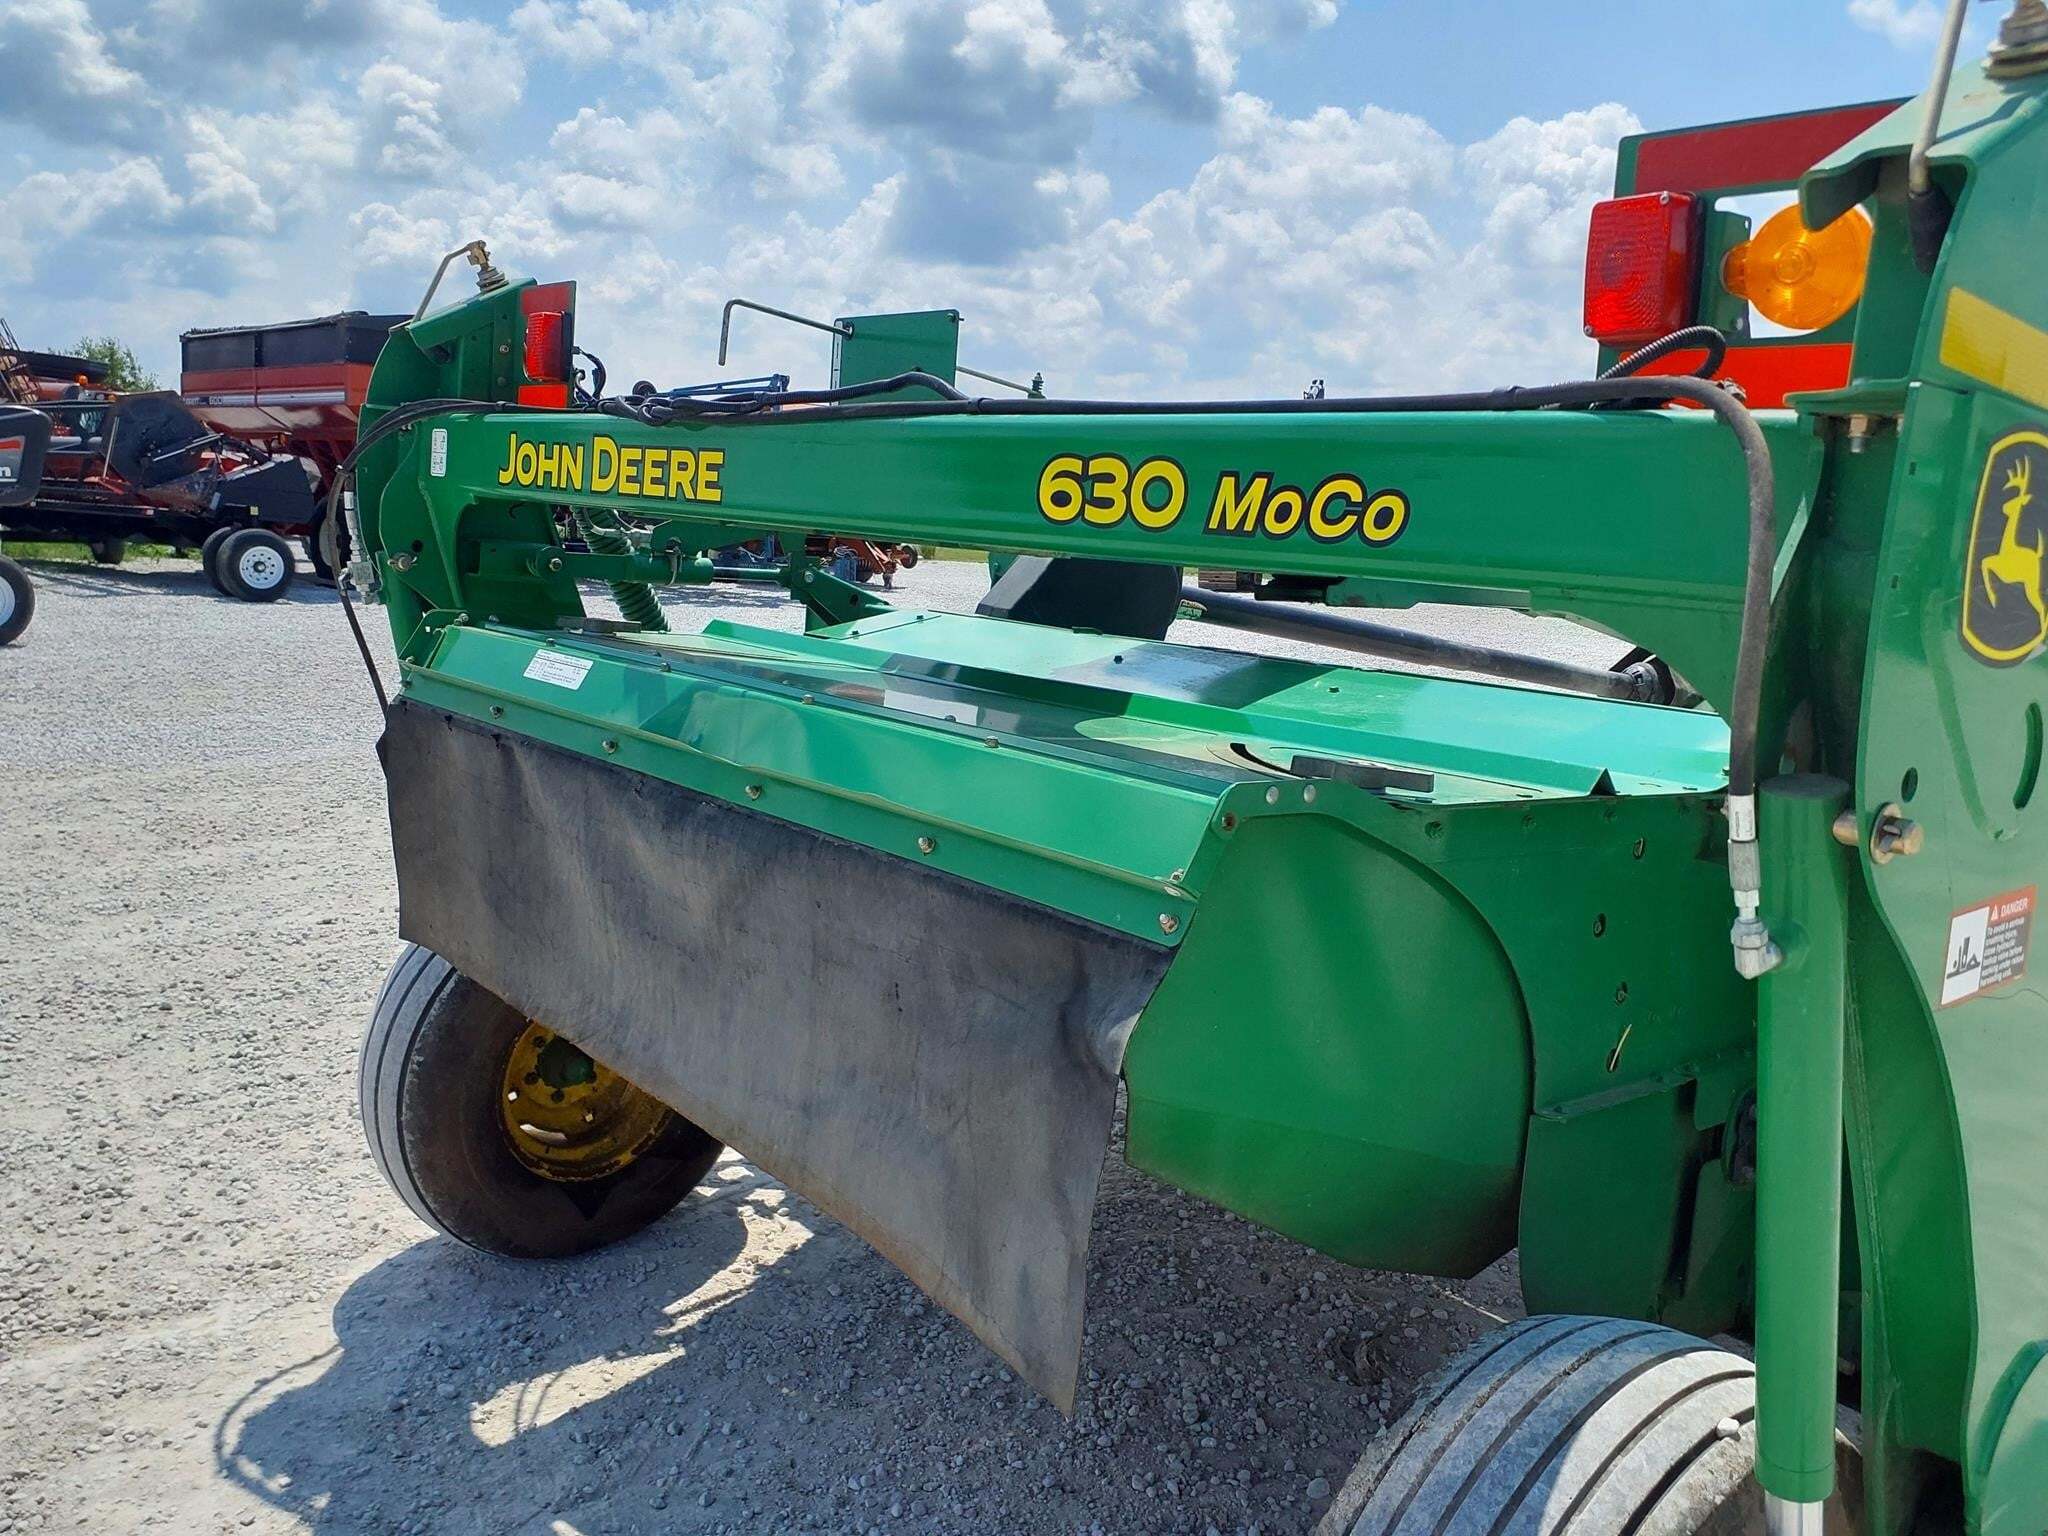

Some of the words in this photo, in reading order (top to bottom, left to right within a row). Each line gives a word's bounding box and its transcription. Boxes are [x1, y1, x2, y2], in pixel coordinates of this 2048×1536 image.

[498, 432, 584, 492] JOHN
[589, 433, 727, 504] DEERE
[1038, 453, 1187, 531] 630
[1204, 471, 1409, 546] MoCo
[2000, 897, 2028, 917] DANGER
